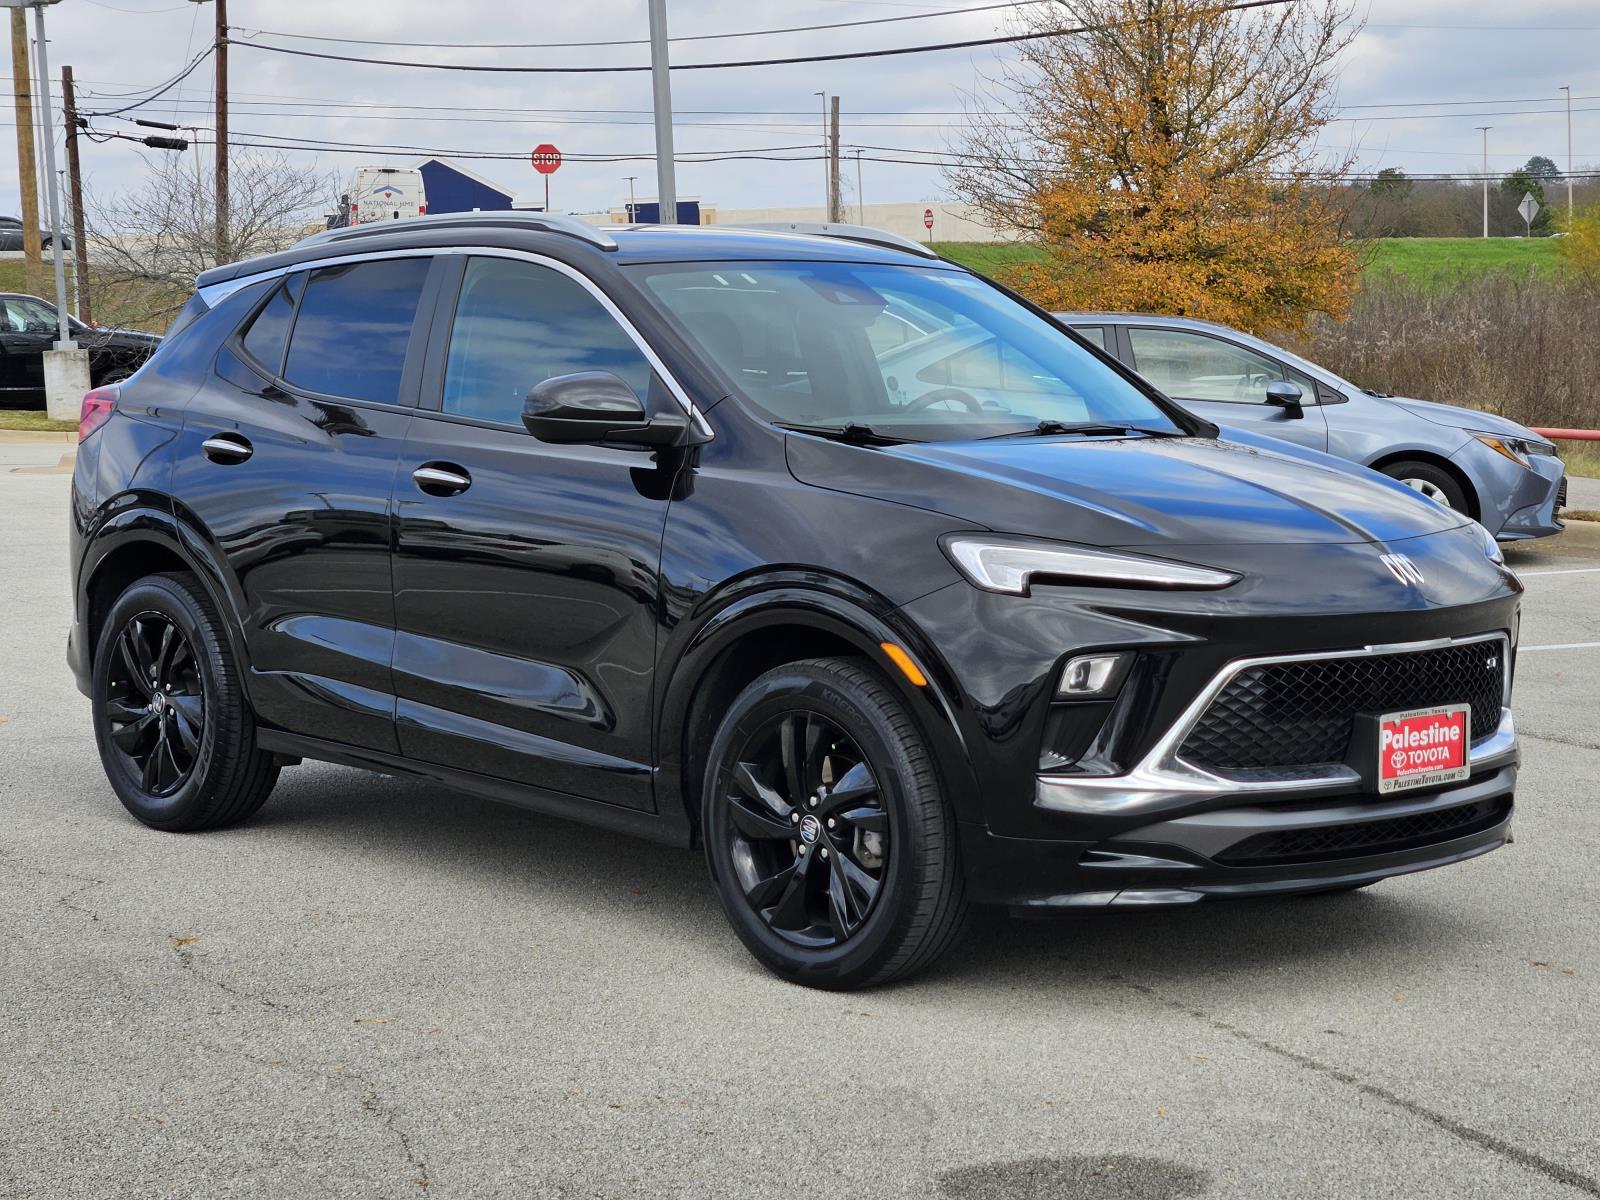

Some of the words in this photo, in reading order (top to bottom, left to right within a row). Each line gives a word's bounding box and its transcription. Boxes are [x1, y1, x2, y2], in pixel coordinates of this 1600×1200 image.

[533, 153, 560, 165] STOP
[1382, 722, 1459, 750] Palestine
[1408, 746, 1450, 764] TOYOTA
